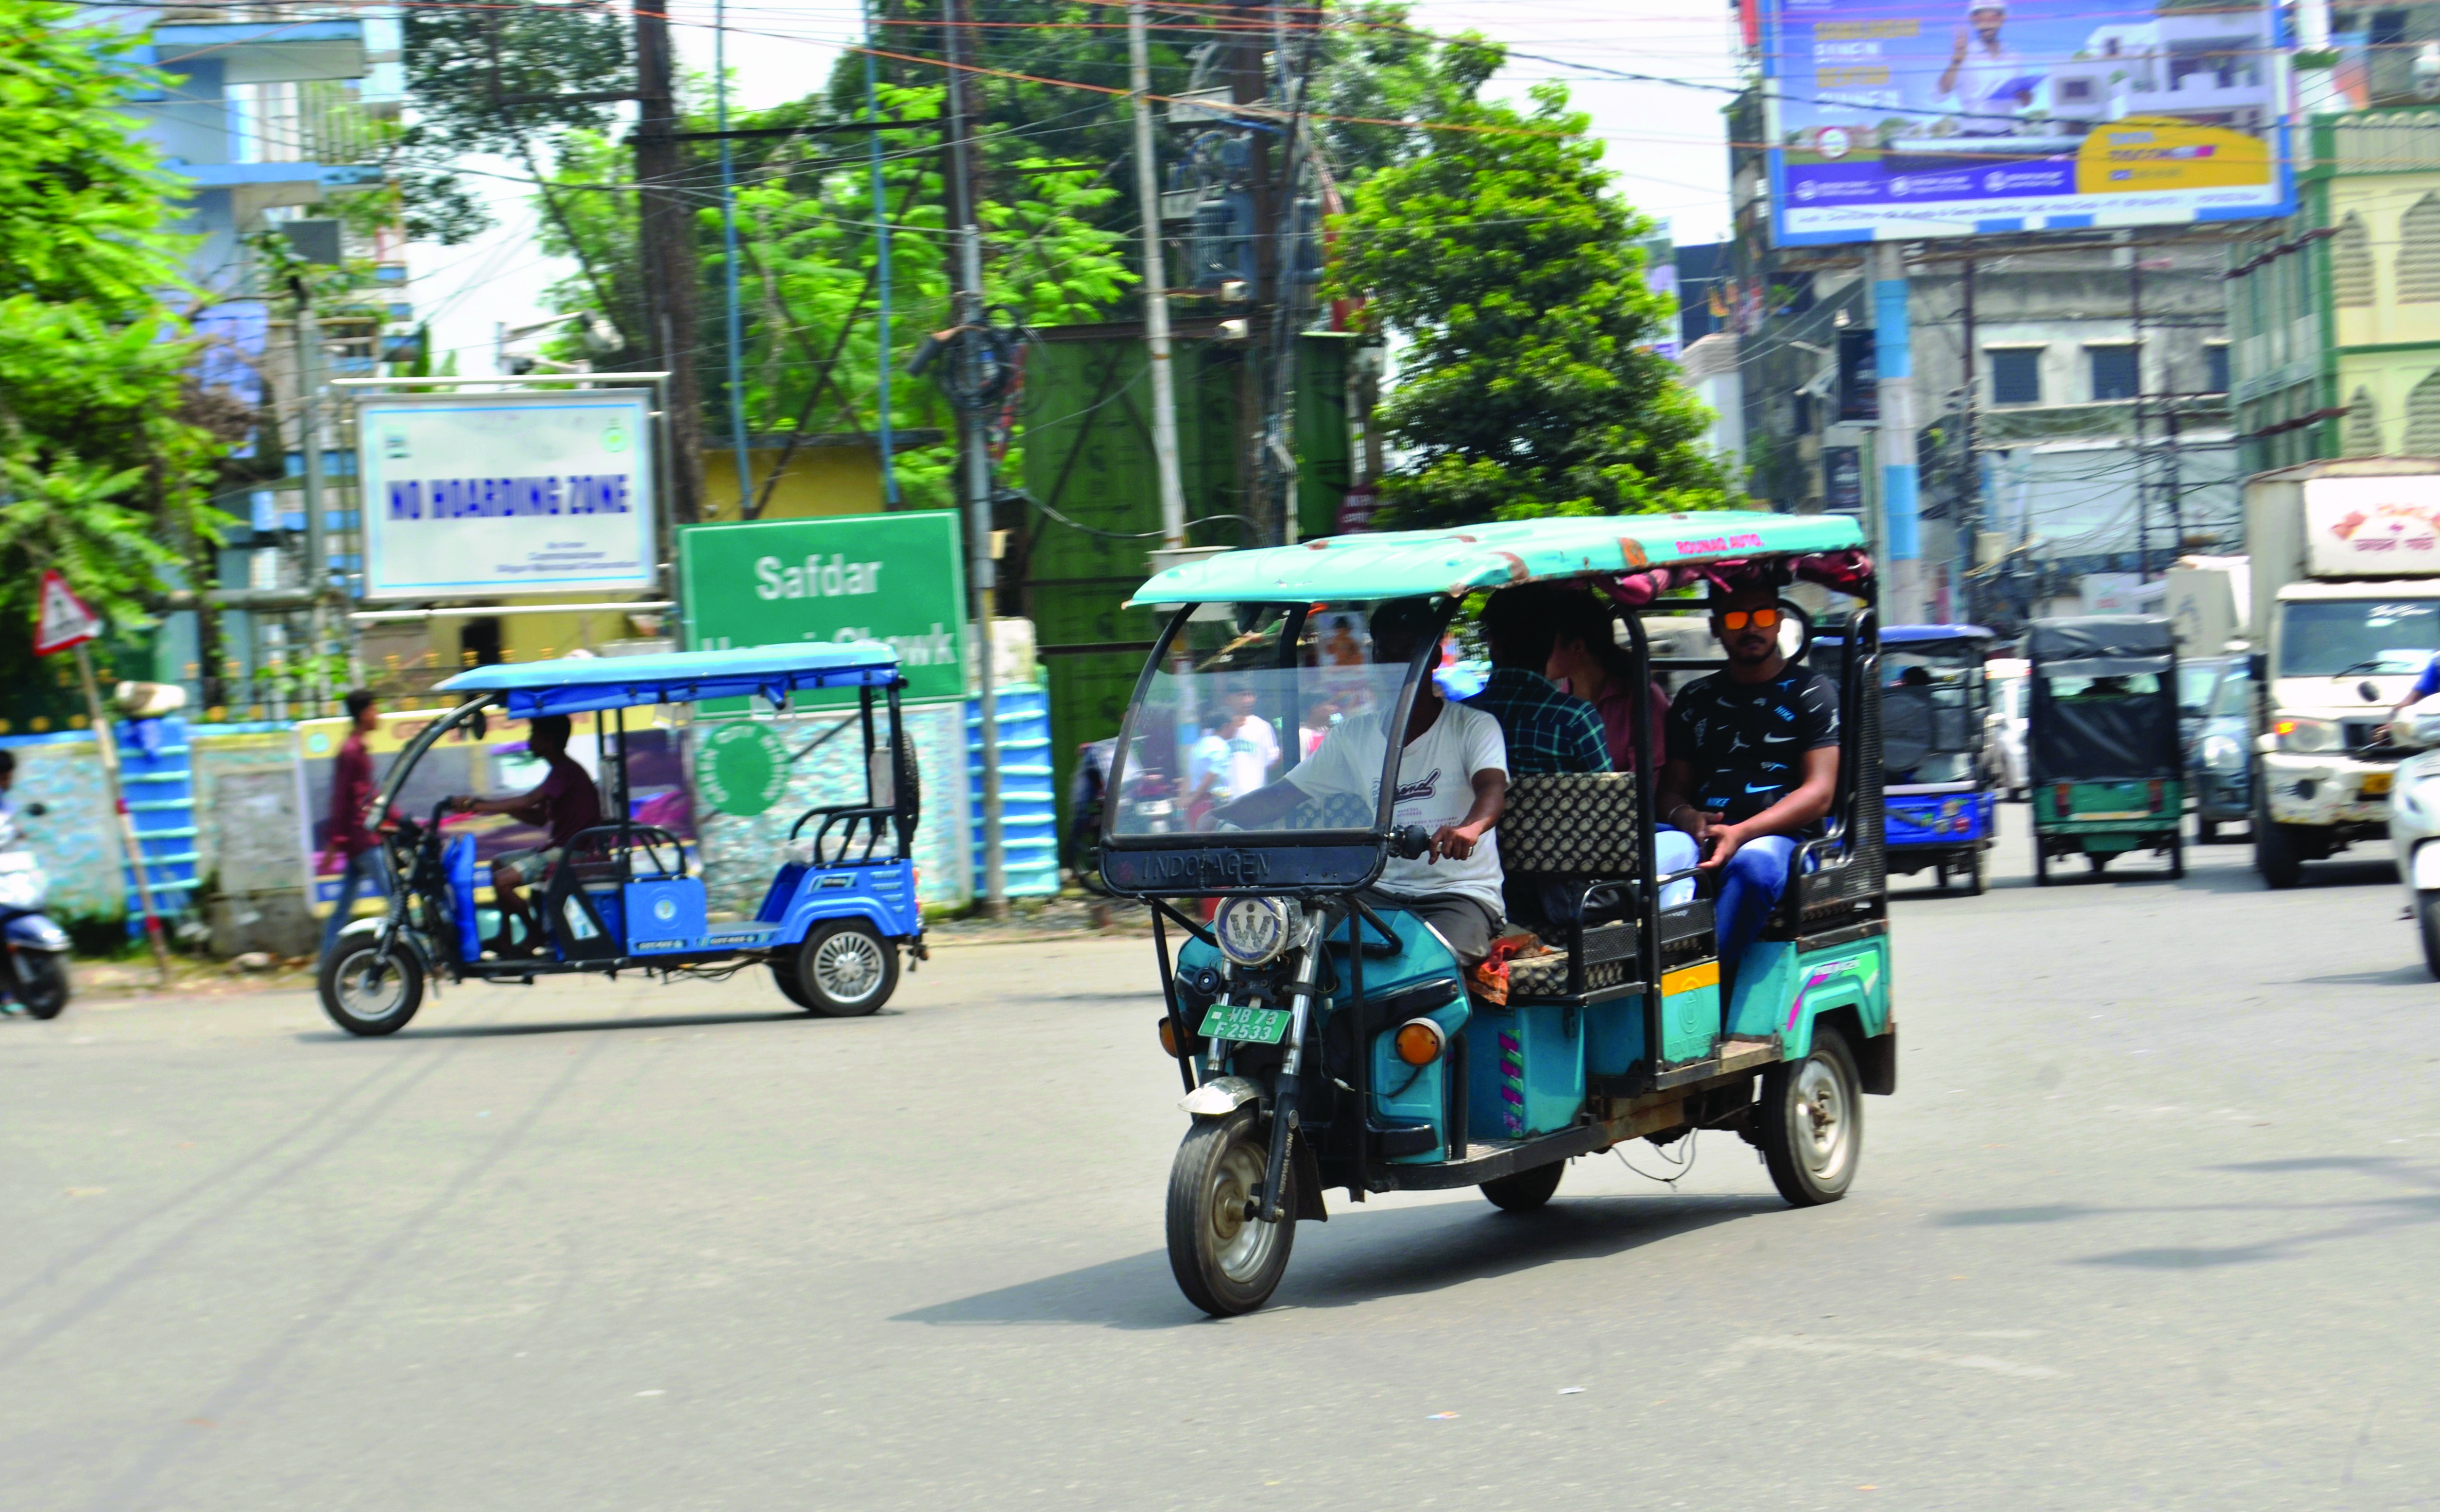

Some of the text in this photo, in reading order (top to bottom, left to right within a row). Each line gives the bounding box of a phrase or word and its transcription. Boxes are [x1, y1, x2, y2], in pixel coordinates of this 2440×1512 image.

[566, 474, 629, 514] ZONE
[755, 553, 883, 600] Safdar
[1774, 705, 1796, 722] NIKE
[1705, 797, 1730, 807] NIKE
[1229, 1008, 1279, 1025] WB 73
[1213, 1022, 1273, 1040] F 2533
